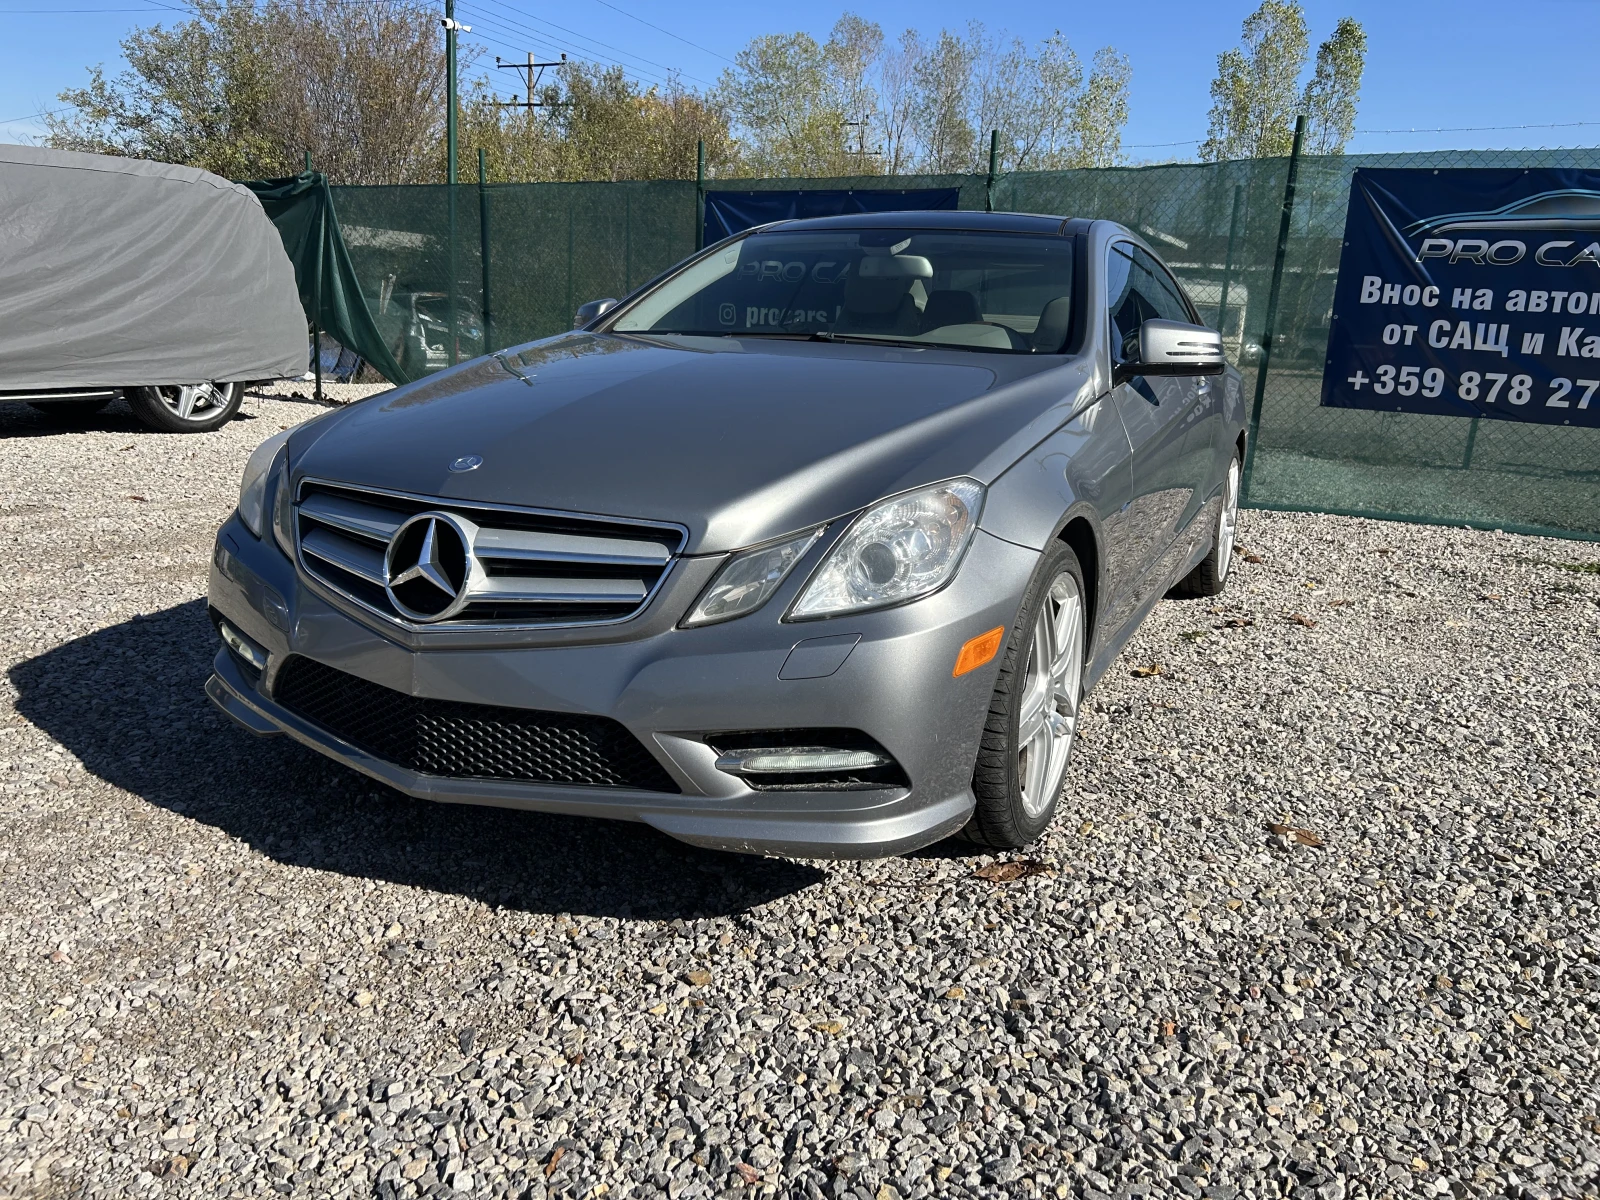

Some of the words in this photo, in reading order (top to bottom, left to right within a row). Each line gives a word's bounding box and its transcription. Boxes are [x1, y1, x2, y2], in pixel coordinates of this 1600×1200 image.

[1415, 238, 1527, 265] PRO
[1535, 240, 1600, 267] CA
[736, 260, 807, 283] PRO
[1360, 275, 1440, 307] Внос
[1451, 288, 1494, 311] на
[1382, 324, 1418, 346] от
[1428, 319, 1510, 358] САЩ
[1520, 332, 1545, 355] и
[1556, 326, 1600, 359] Ка
[1347, 364, 1445, 398] +359
[1458, 371, 1533, 405] 878
[1545, 377, 1600, 410] 27
